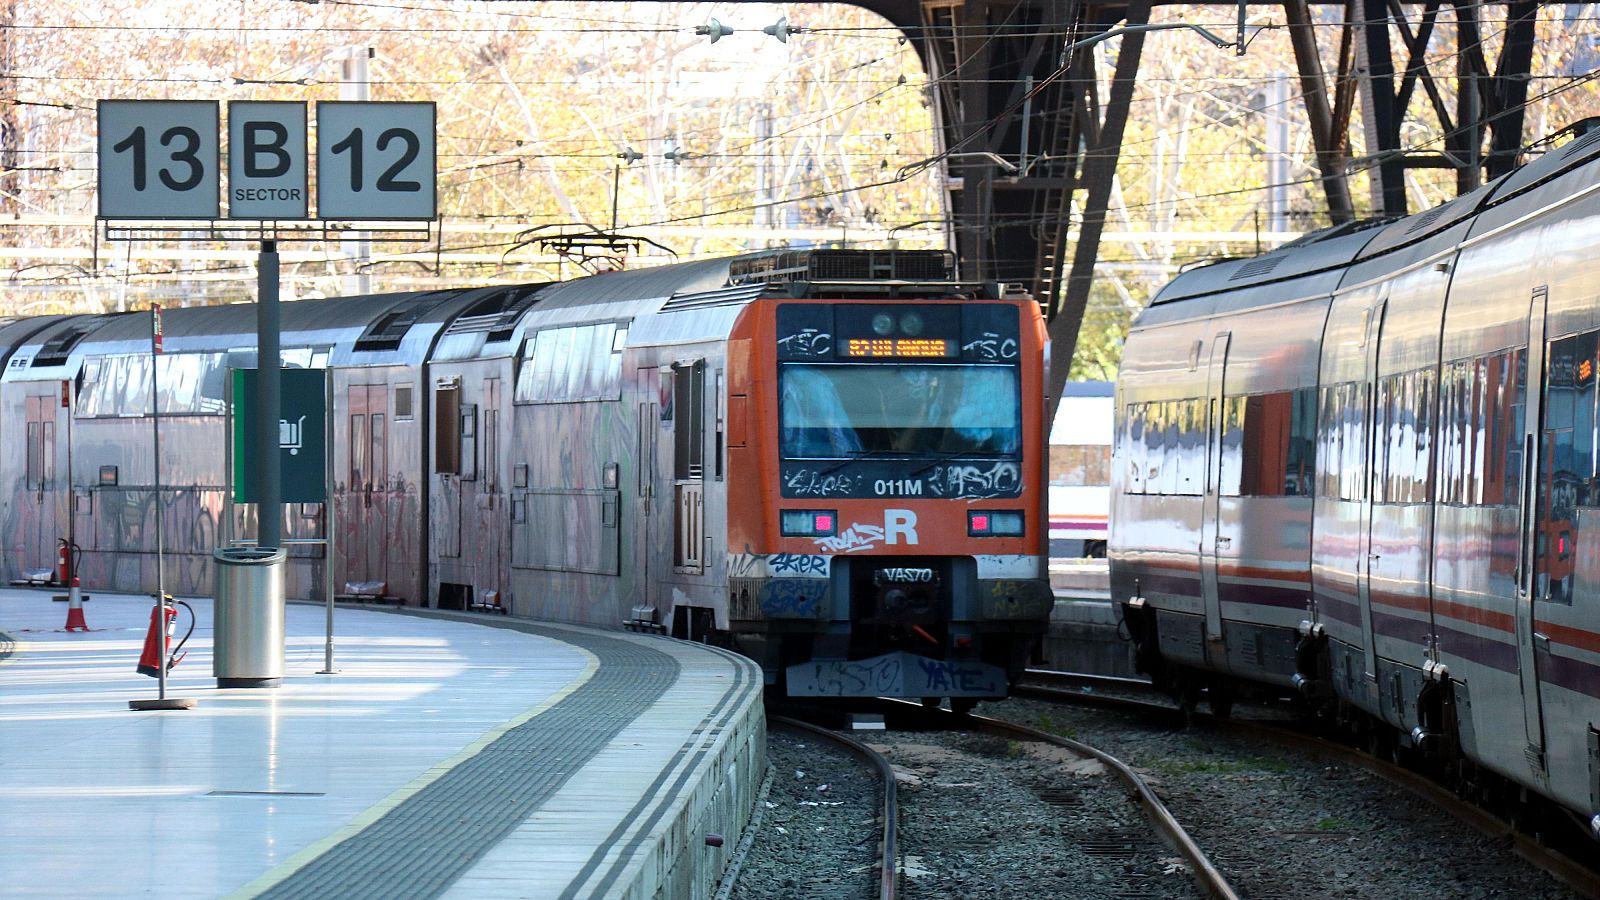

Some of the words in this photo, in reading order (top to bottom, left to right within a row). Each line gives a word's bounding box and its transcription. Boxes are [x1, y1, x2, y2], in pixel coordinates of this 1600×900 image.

[113, 125, 204, 192] 13
[243, 121, 292, 178] B
[331, 127, 421, 193] 12
[235, 188, 301, 201] SECTOR
[874, 479, 922, 495] 011M
[884, 508, 919, 545] R
[883, 567, 933, 583] VASTO
